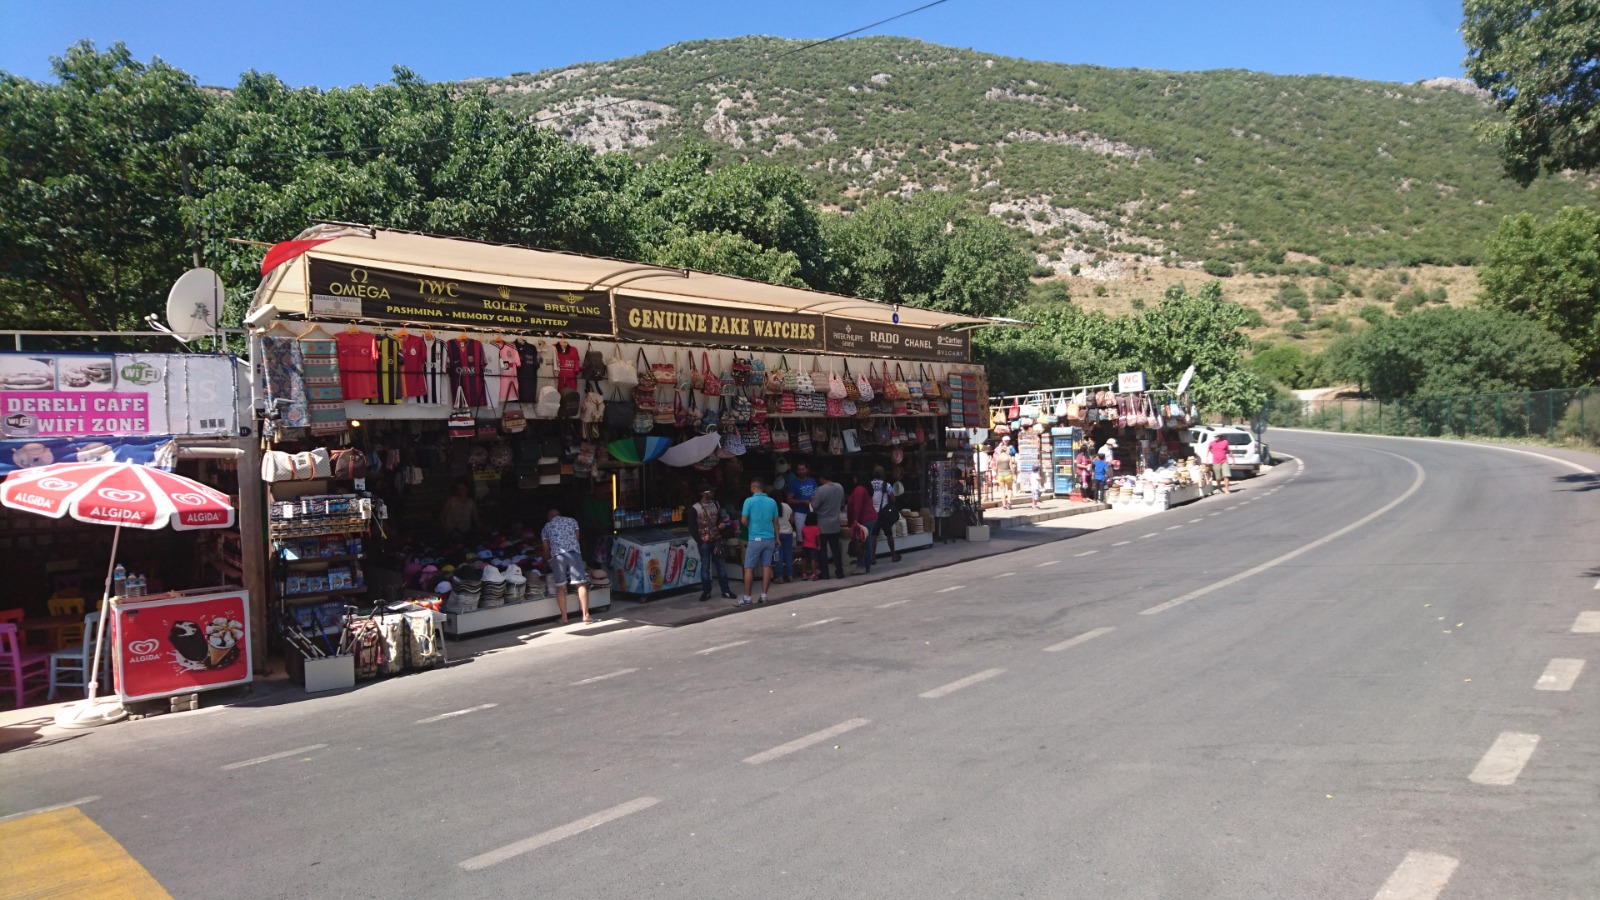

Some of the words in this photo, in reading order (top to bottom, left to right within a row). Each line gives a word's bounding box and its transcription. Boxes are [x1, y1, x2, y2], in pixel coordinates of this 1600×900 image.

[329, 282, 391, 300] OMEGA
[418, 279, 461, 298] IWC
[482, 299, 528, 312] ROLEX
[544, 303, 600, 315] BREITLING
[386, 305, 443, 317] PASHMINA
[452, 312, 495, 321] MEMORY
[497, 315, 522, 324] CARD
[530, 317, 568, 327] BATTERY
[628, 307, 707, 333] GENUINE
[711, 315, 749, 336] FAKE
[753, 319, 816, 340] WATCHES
[870, 331, 899, 344] RADO
[904, 338, 933, 349] CHANEL
[946, 336, 963, 345] Cartier
[1122, 374, 1139, 384] WC
[7, 394, 87, 412] DERELİ
[94, 398, 145, 412] CAFE
[37, 415, 84, 432] WİFİ
[92, 418, 145, 431] ZONE
